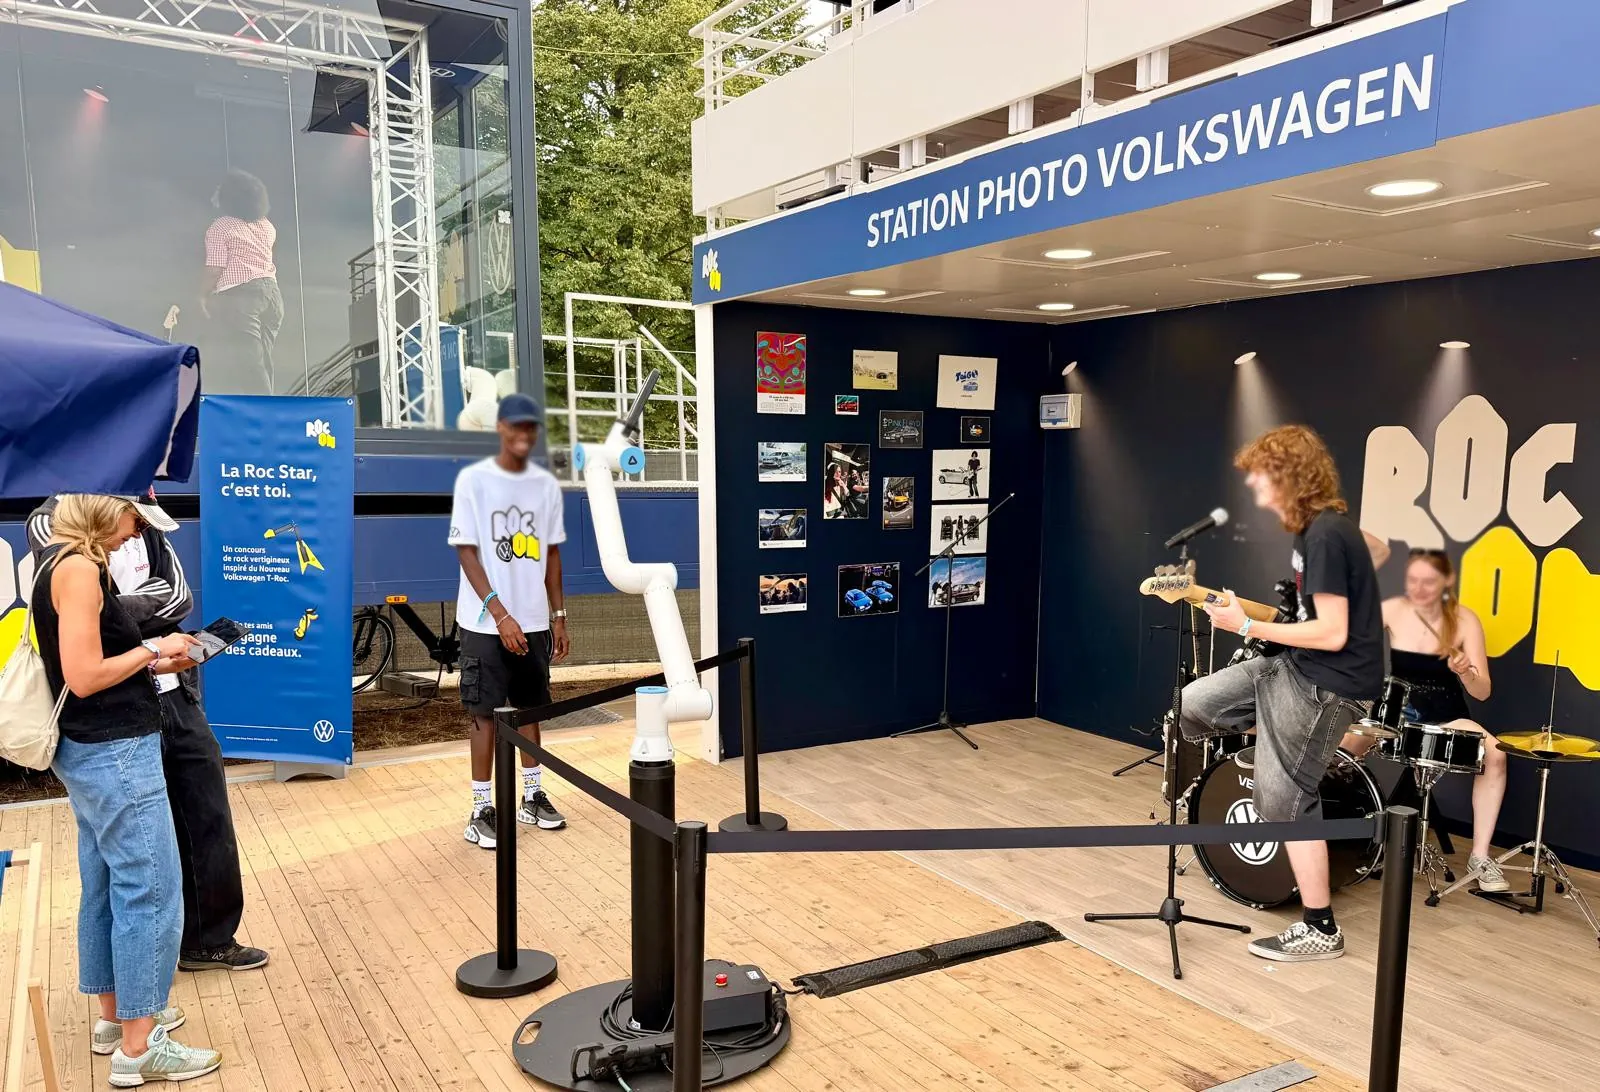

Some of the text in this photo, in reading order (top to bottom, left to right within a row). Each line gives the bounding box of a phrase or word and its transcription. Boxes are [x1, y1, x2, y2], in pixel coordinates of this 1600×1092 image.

[867, 54, 1434, 248] STATION PHOTO VOLKSWAGEN
[306, 418, 331, 437] ROC
[318, 432, 336, 449] ON
[221, 463, 317, 483] La Roc Star,
[1359, 394, 1583, 550] ROC
[221, 482, 292, 498] c'est toi.
[491, 504, 536, 542] ROC
[222, 545, 233, 553] Un
[223, 554, 232, 562] de
[249, 556, 290, 564] vertigineux
[223, 564, 290, 573] inspiré du Nouveau
[223, 573, 290, 583] Volkswagen T-Roc.
[256, 622, 273, 630] amis
[240, 633, 278, 645] gagne
[225, 645, 302, 658] des cadeaux.
